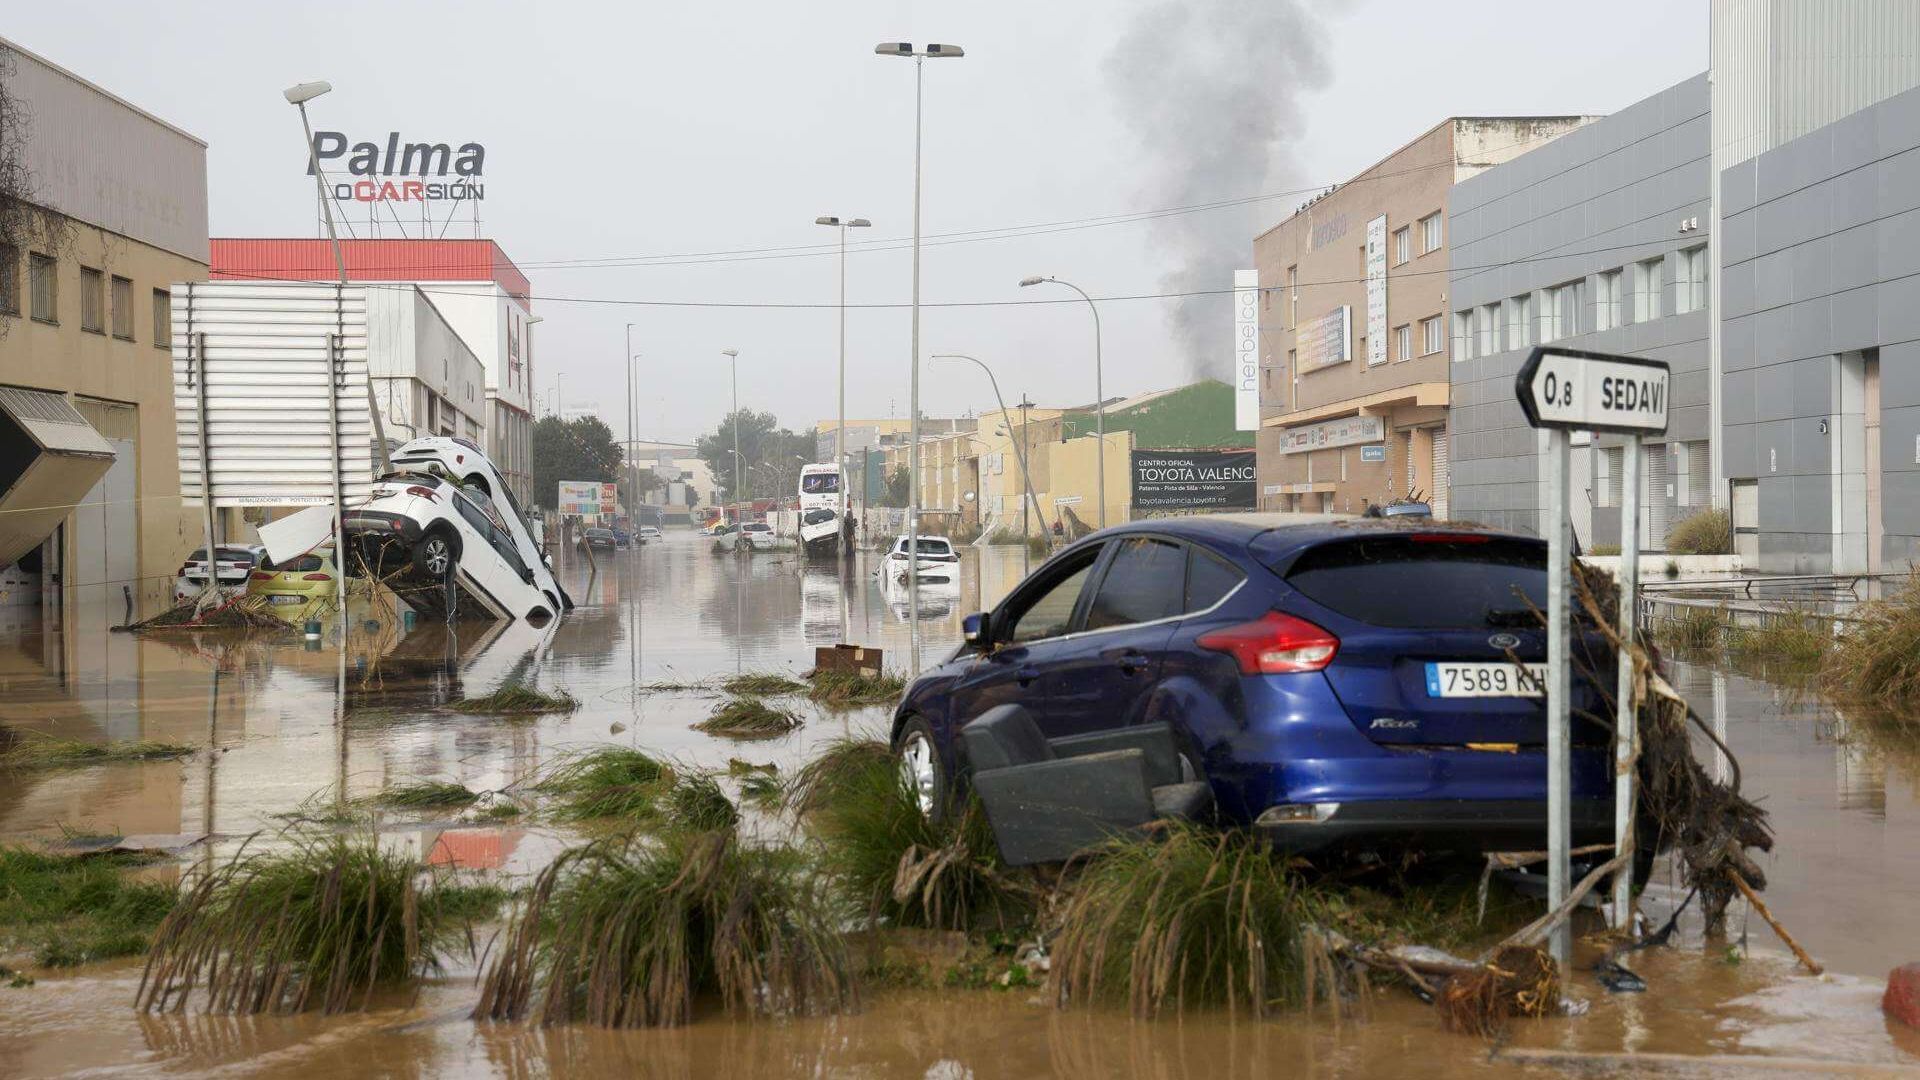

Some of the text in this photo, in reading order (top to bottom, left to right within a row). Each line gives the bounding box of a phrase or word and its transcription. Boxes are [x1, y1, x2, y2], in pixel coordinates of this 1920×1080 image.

[307, 131, 485, 176] Palma
[1237, 292, 1256, 392] herbelca
[1544, 371, 1665, 414] 0,8 SEDAVÍ
[1139, 467, 1256, 481] TOYOTA VALENCI
[1445, 668, 1548, 692] 7589 KH
